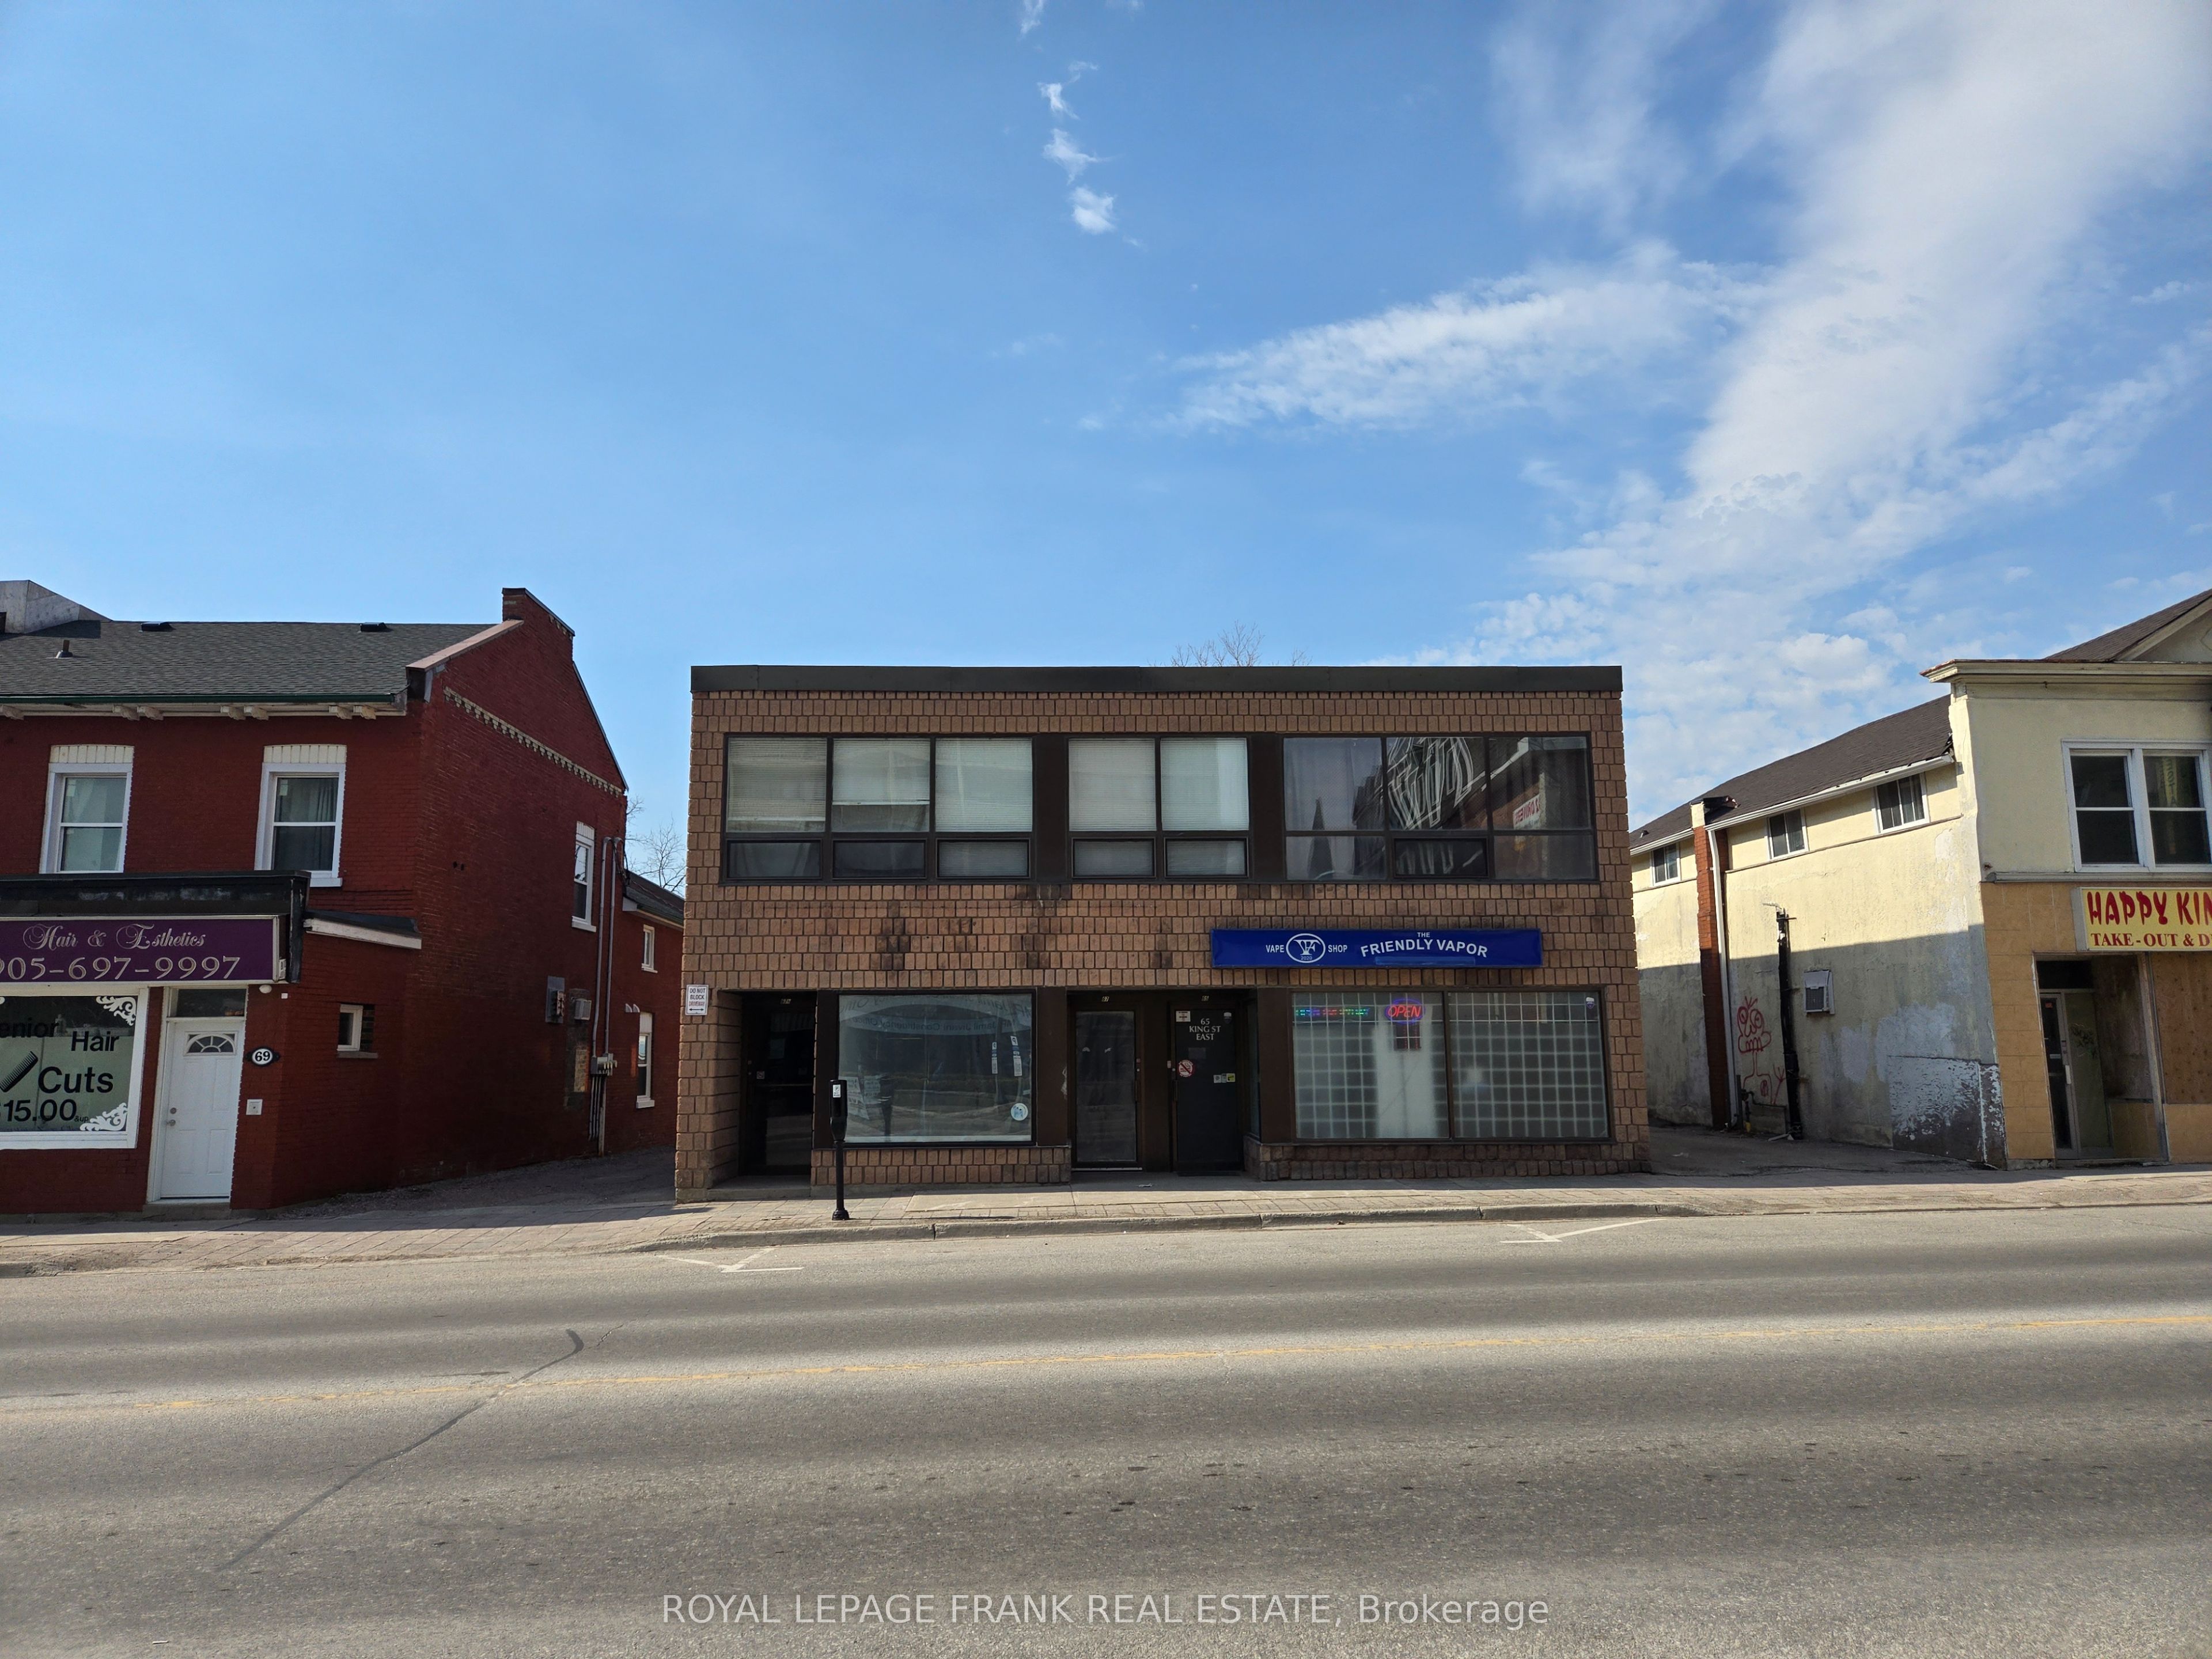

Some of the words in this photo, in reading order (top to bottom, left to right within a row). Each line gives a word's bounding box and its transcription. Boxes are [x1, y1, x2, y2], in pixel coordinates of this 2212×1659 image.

[2087, 891, 2168, 925] HAPPY
[23, 925, 78, 950] Hair
[88, 930, 107, 947] &
[116, 923, 206, 949] Esthetics
[2183, 933, 2194, 946] &
[2198, 933, 2212, 946] D
[1266, 945, 1284, 953] VAPE
[1328, 945, 1347, 953] SHOP
[1361, 939, 1433, 957] FRIENDLY
[1437, 940, 1488, 957] VAPOR
[1387, 1005, 1422, 1018] OPEN
[71, 1031, 119, 1051] Hair
[255, 1051, 271, 1062] 69
[38, 1066, 113, 1093] Cuts
[0, 1099, 77, 1122] 15.00
